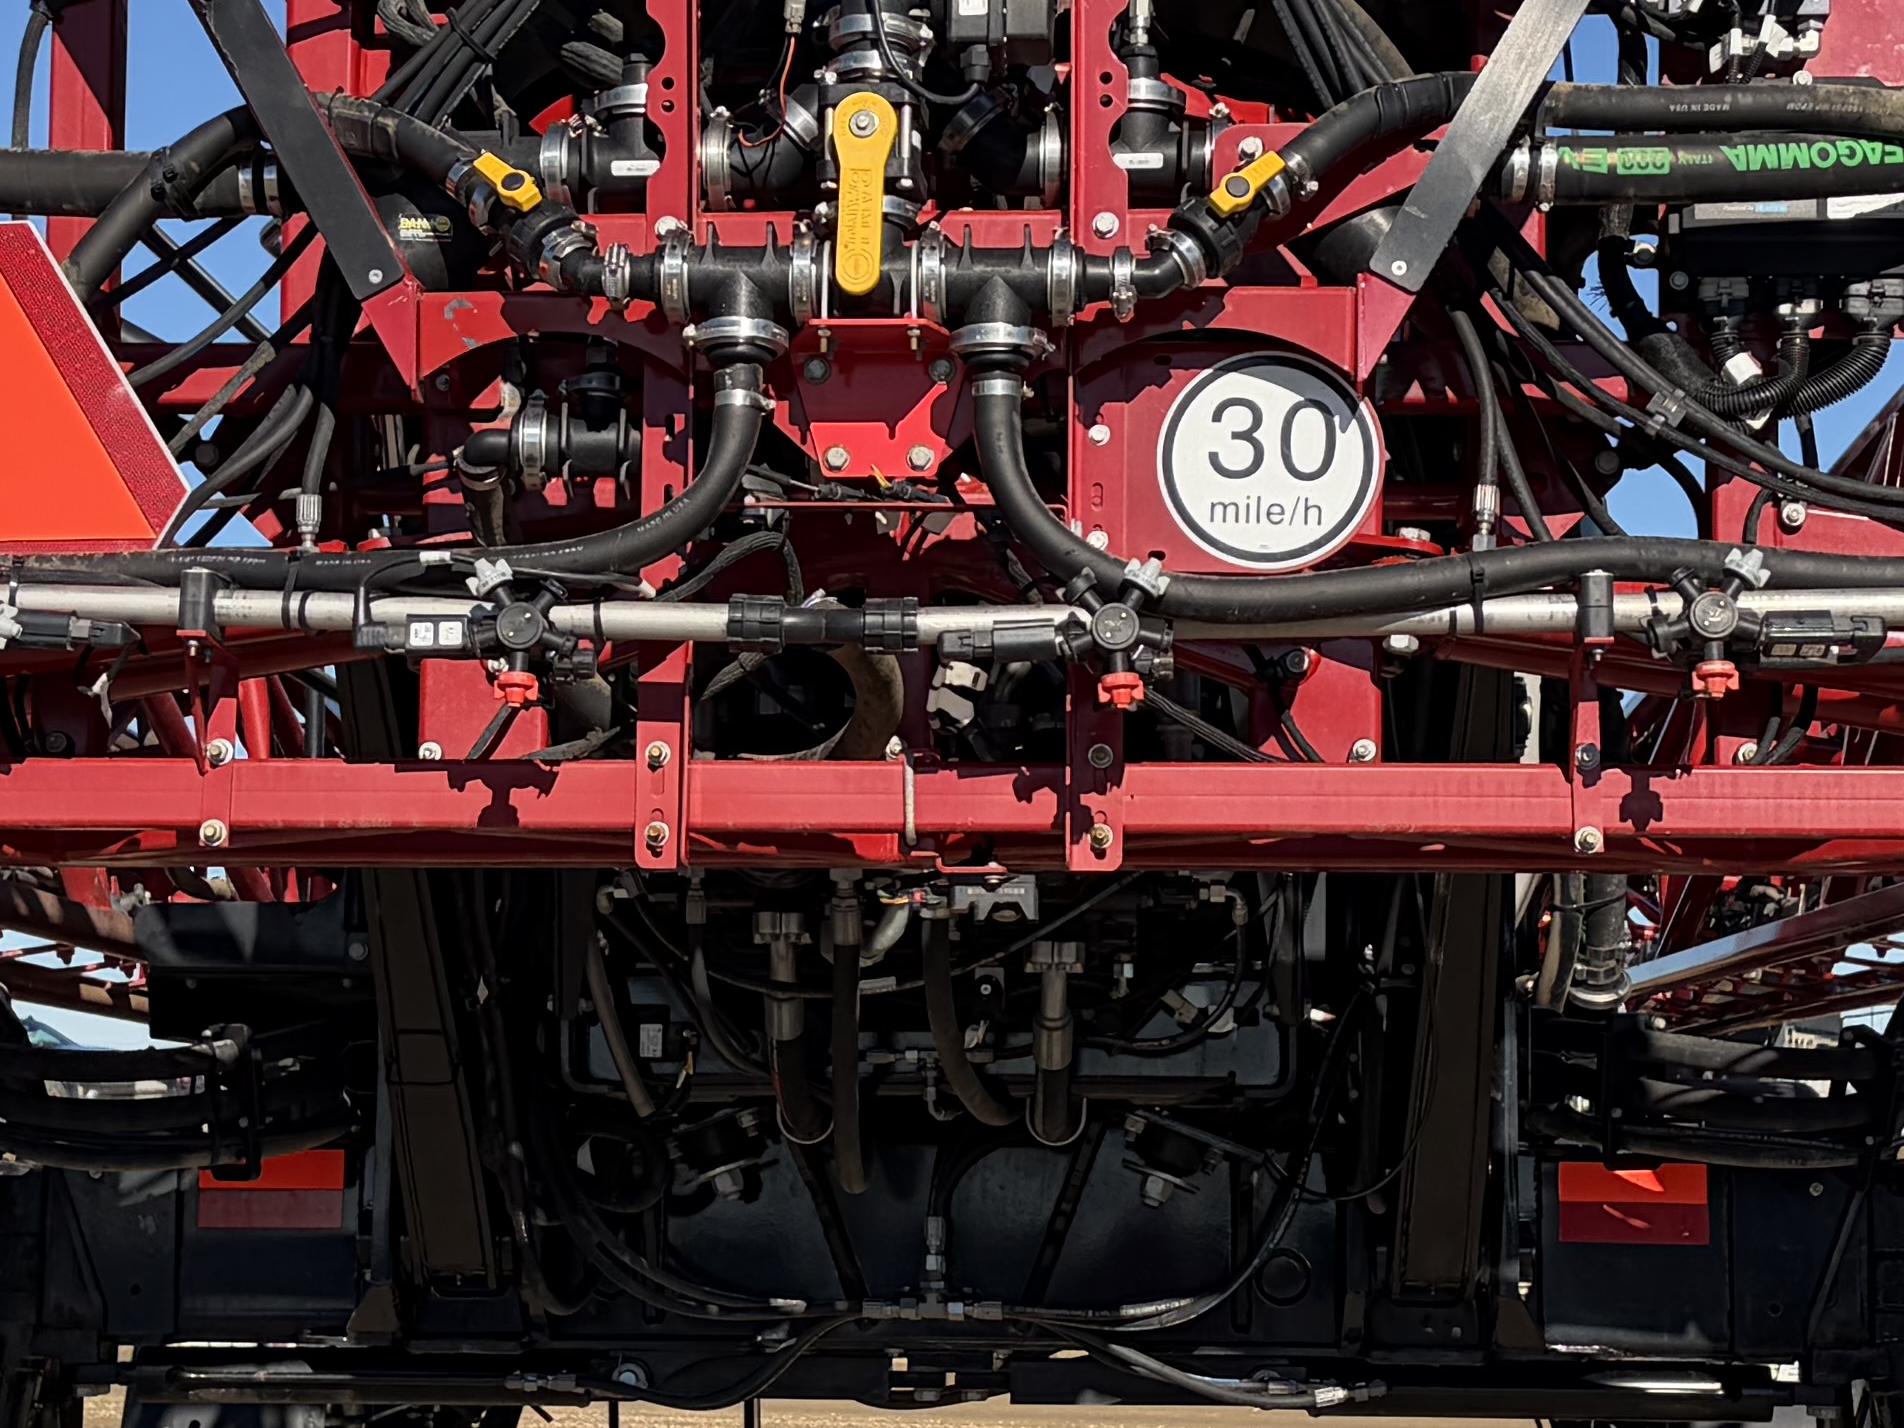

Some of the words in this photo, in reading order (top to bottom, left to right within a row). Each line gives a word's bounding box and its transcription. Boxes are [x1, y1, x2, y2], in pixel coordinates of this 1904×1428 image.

[1669, 104, 1689, 112] USA
[1208, 397, 1337, 482] 30
[1210, 495, 1323, 527] mile/h
